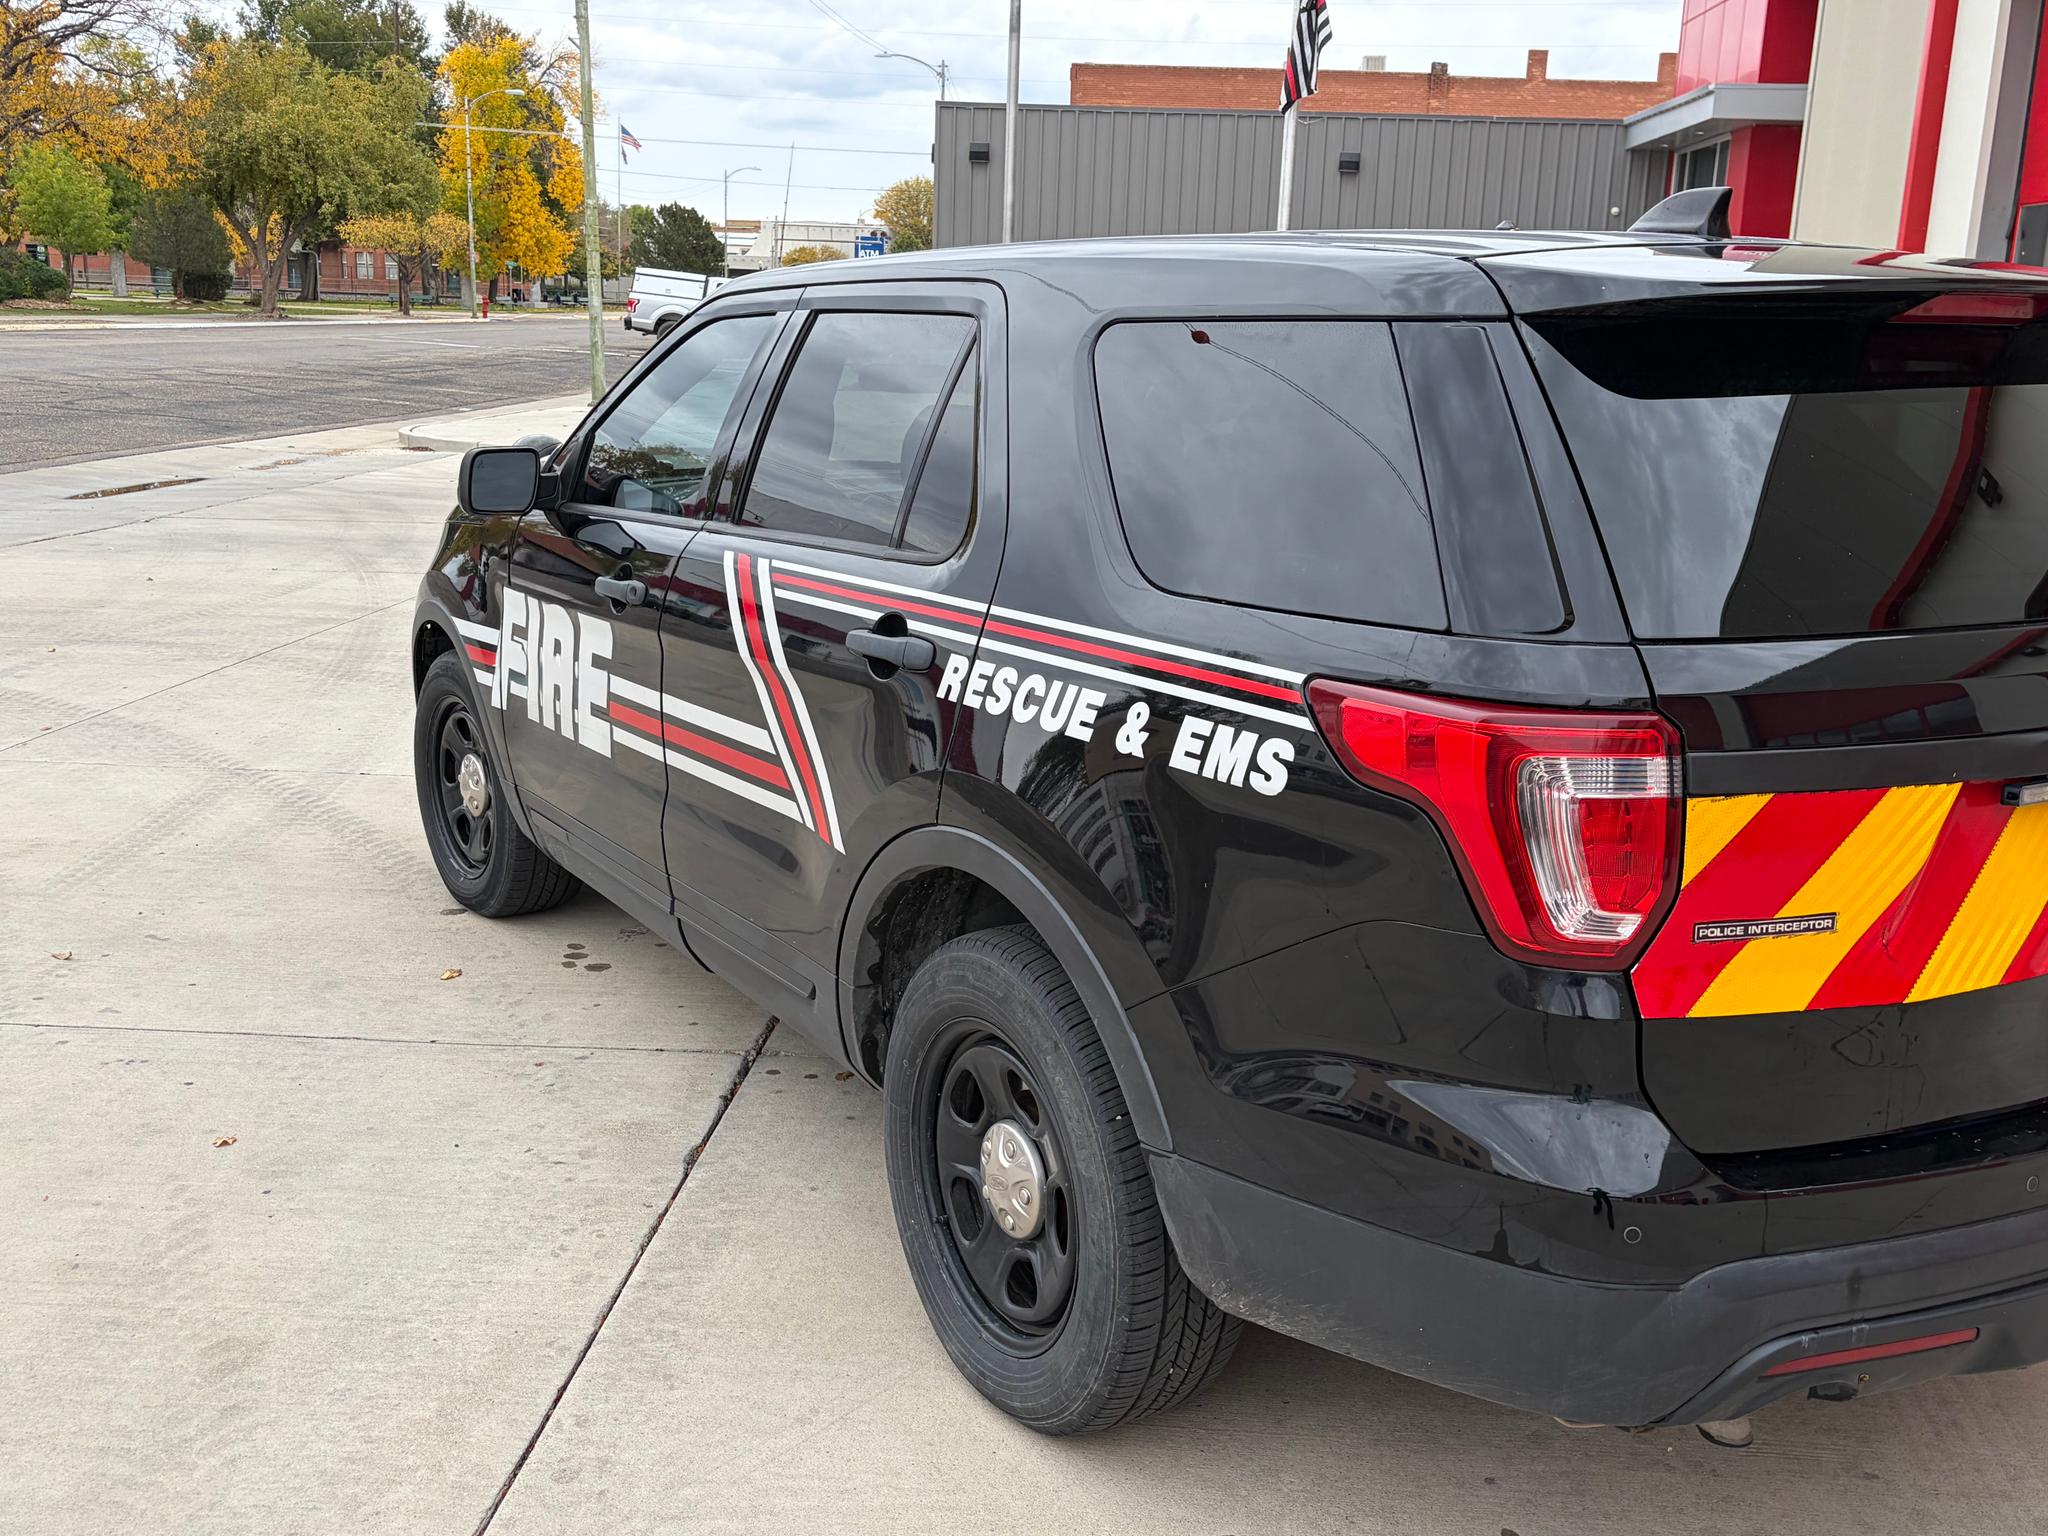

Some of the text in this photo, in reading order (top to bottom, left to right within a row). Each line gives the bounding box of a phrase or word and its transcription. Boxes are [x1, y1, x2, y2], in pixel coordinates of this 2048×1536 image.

[860, 249, 880, 258] ATM
[491, 586, 613, 758] FIRE
[936, 653, 1295, 796] RESCUE & EMS
[1699, 919, 1832, 938] POLICE INTERCEPTOR
